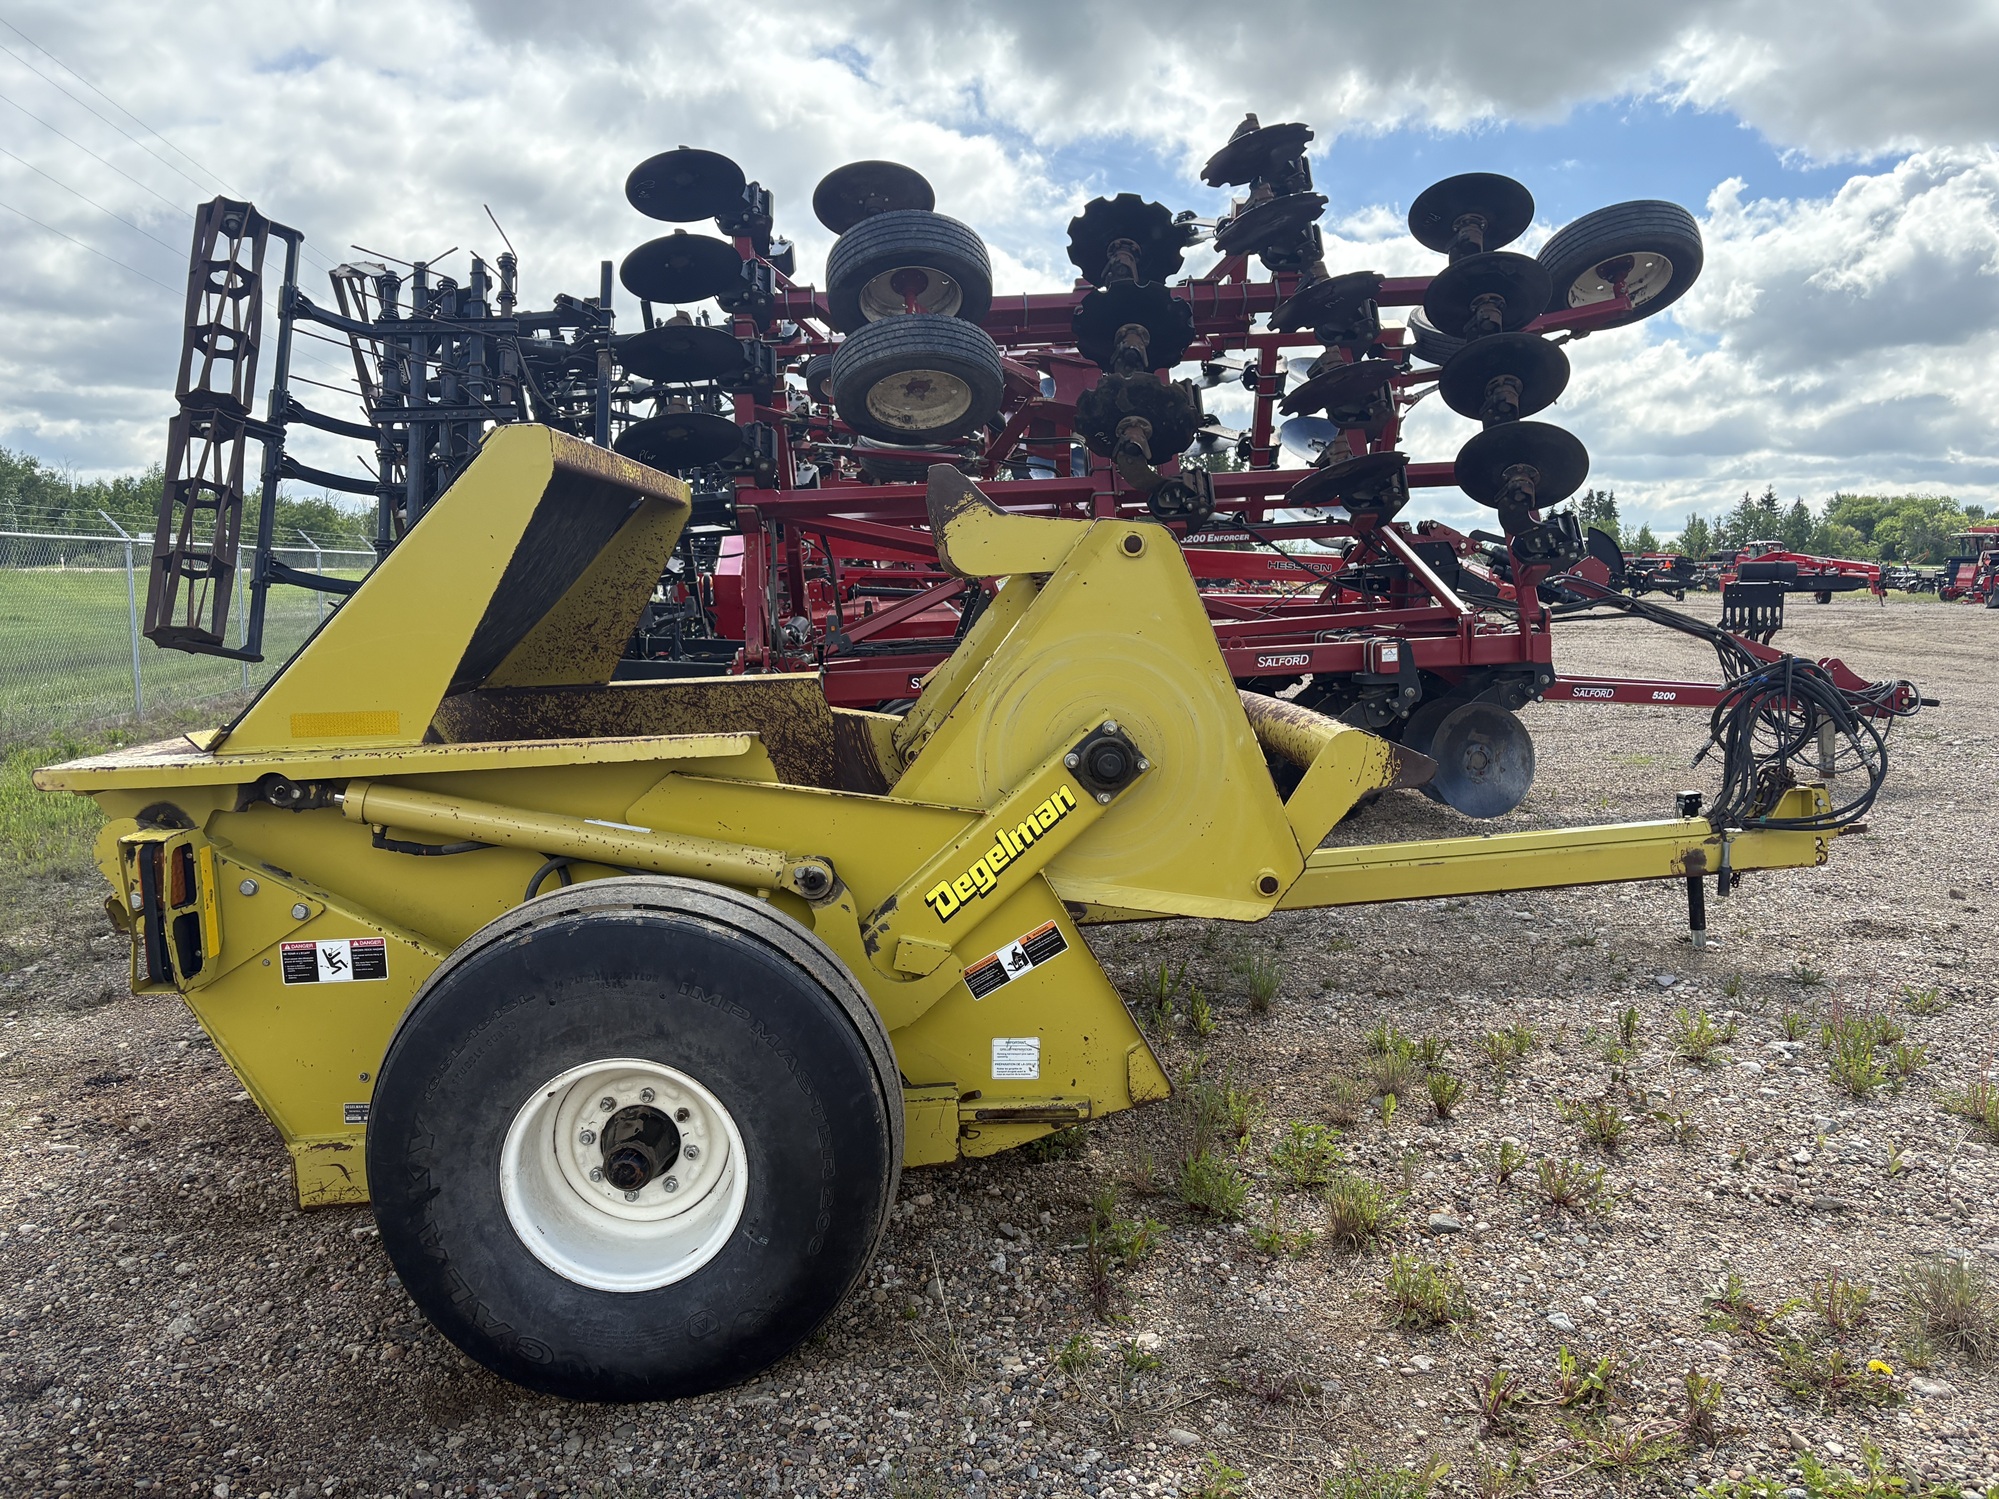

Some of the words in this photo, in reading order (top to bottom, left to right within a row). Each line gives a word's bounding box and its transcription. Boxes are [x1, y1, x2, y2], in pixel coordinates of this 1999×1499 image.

[1207, 533, 1250, 542] ENFORCER
[1267, 560, 1333, 572] HESSTON
[1257, 654, 1310, 668] SALFORD
[1572, 687, 1615, 699] SALFORD
[1651, 691, 1677, 701] 5200
[924, 783, 1078, 924] Degelman
